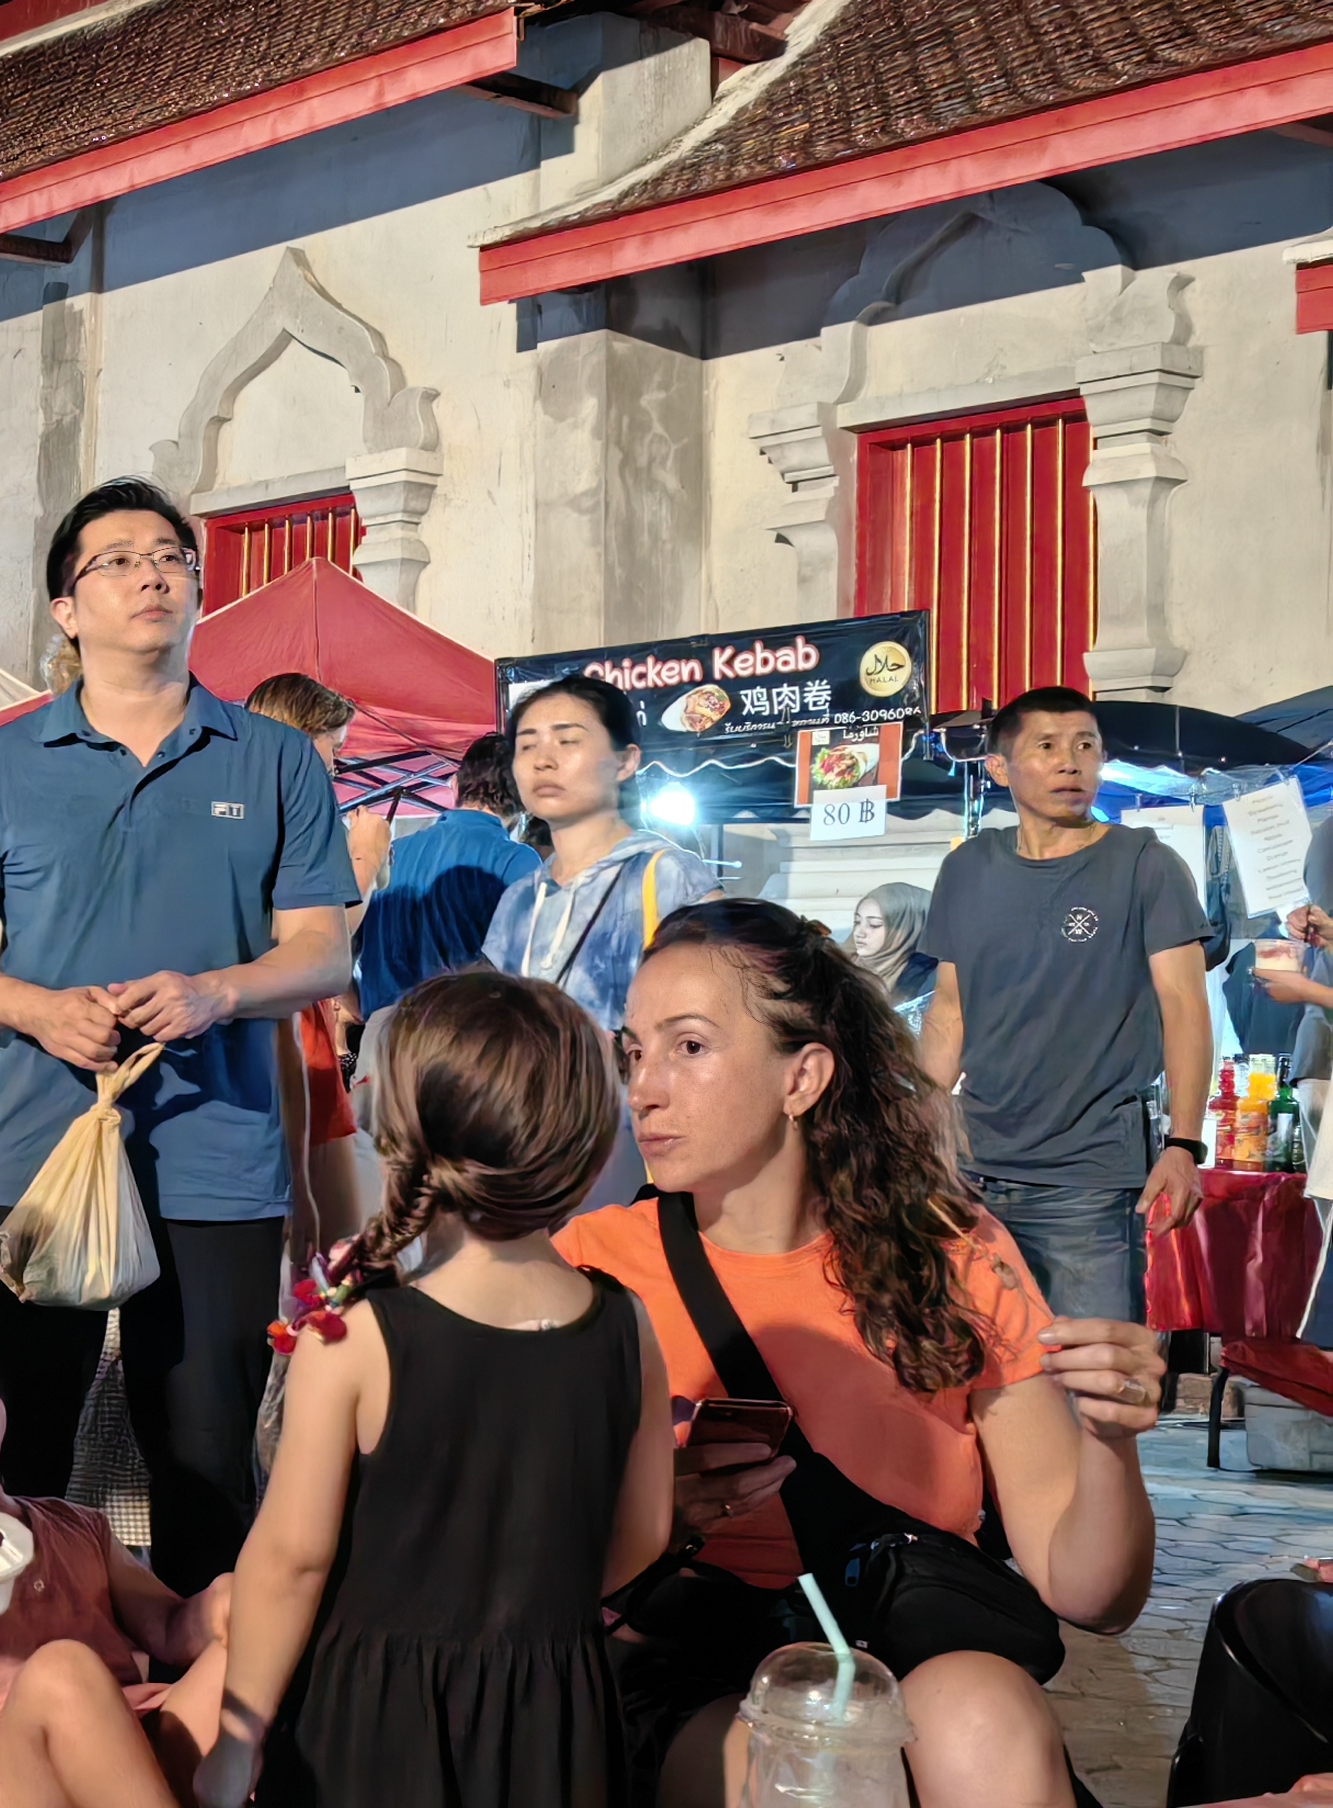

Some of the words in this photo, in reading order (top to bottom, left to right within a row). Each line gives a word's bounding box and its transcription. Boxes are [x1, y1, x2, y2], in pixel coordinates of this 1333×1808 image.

[584, 654, 703, 691] Chicken
[712, 635, 820, 681] Kebab
[865, 653, 905, 676] حلال
[870, 675, 899, 684] HALAL
[739, 680, 832, 716] 鸡肉卷
[823, 803, 850, 826] 80
